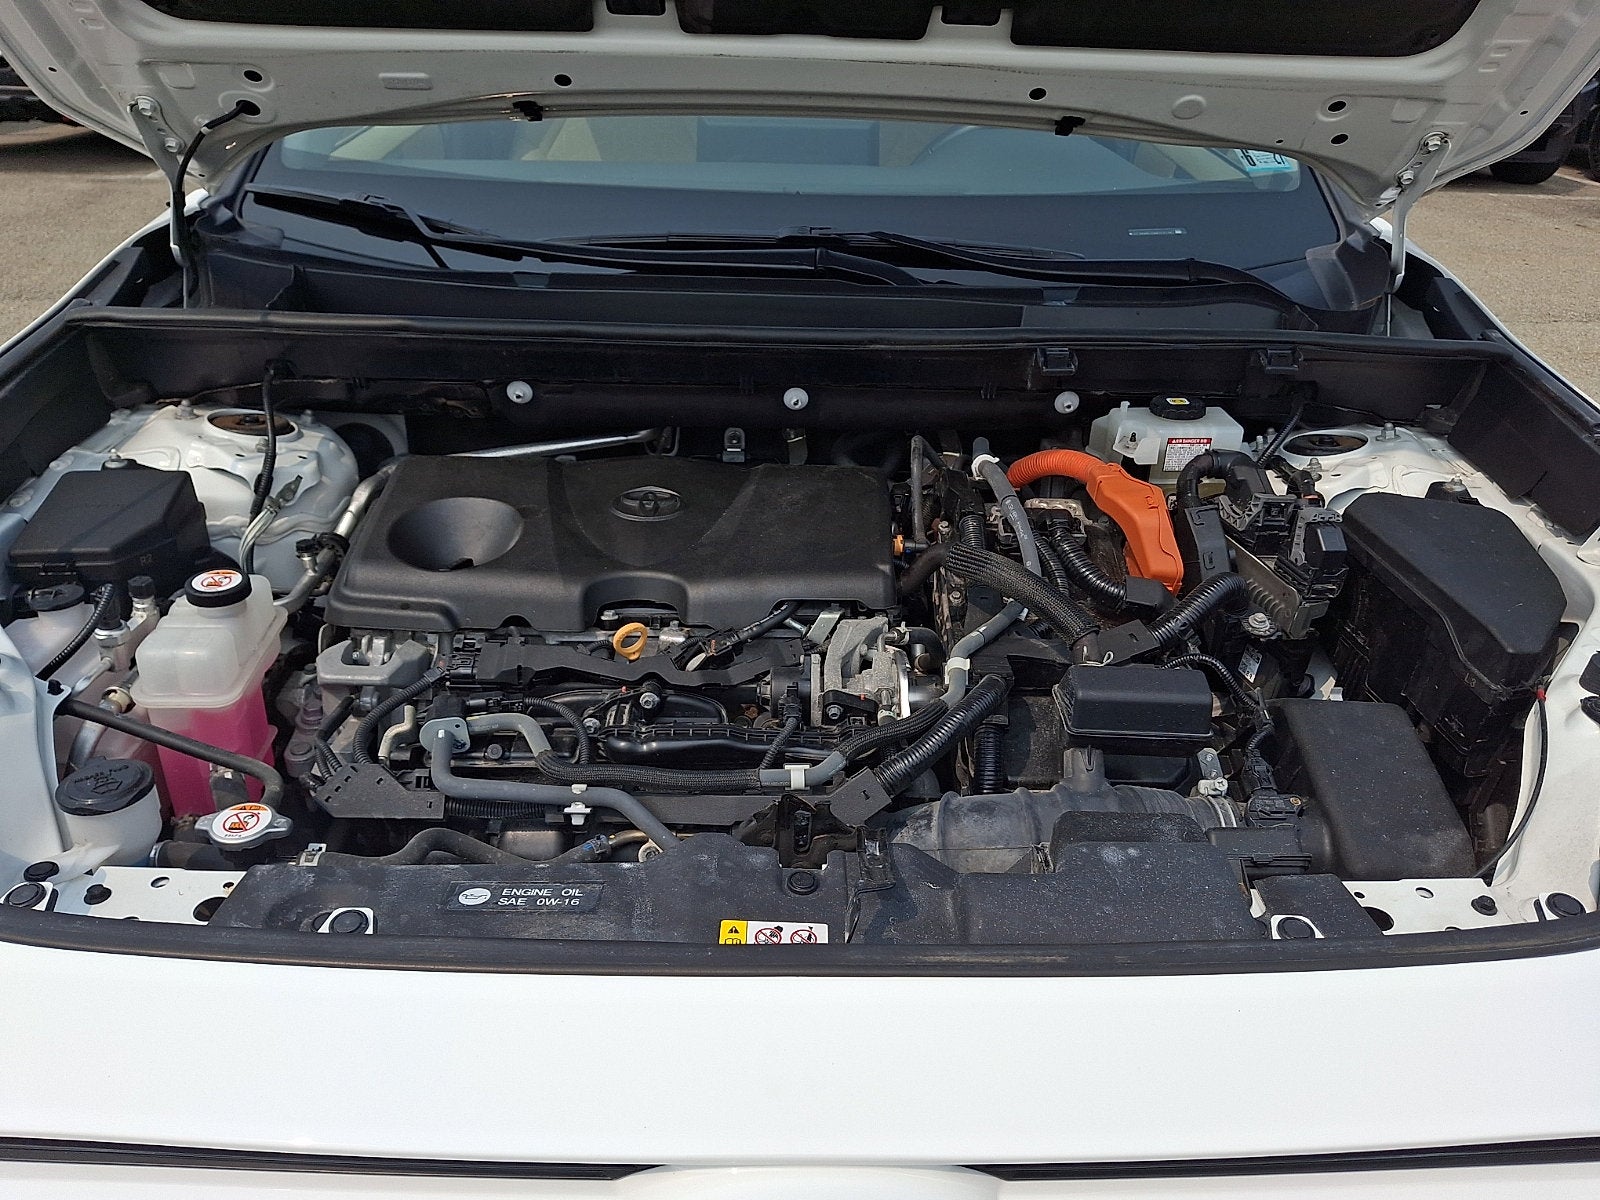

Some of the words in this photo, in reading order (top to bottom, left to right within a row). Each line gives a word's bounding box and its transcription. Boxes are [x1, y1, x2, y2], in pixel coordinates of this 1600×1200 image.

[501, 888, 554, 896] ENGINE
[561, 888, 584, 897] OIL
[497, 898, 528, 906] SAE
[536, 898, 580, 906] 0W-16
